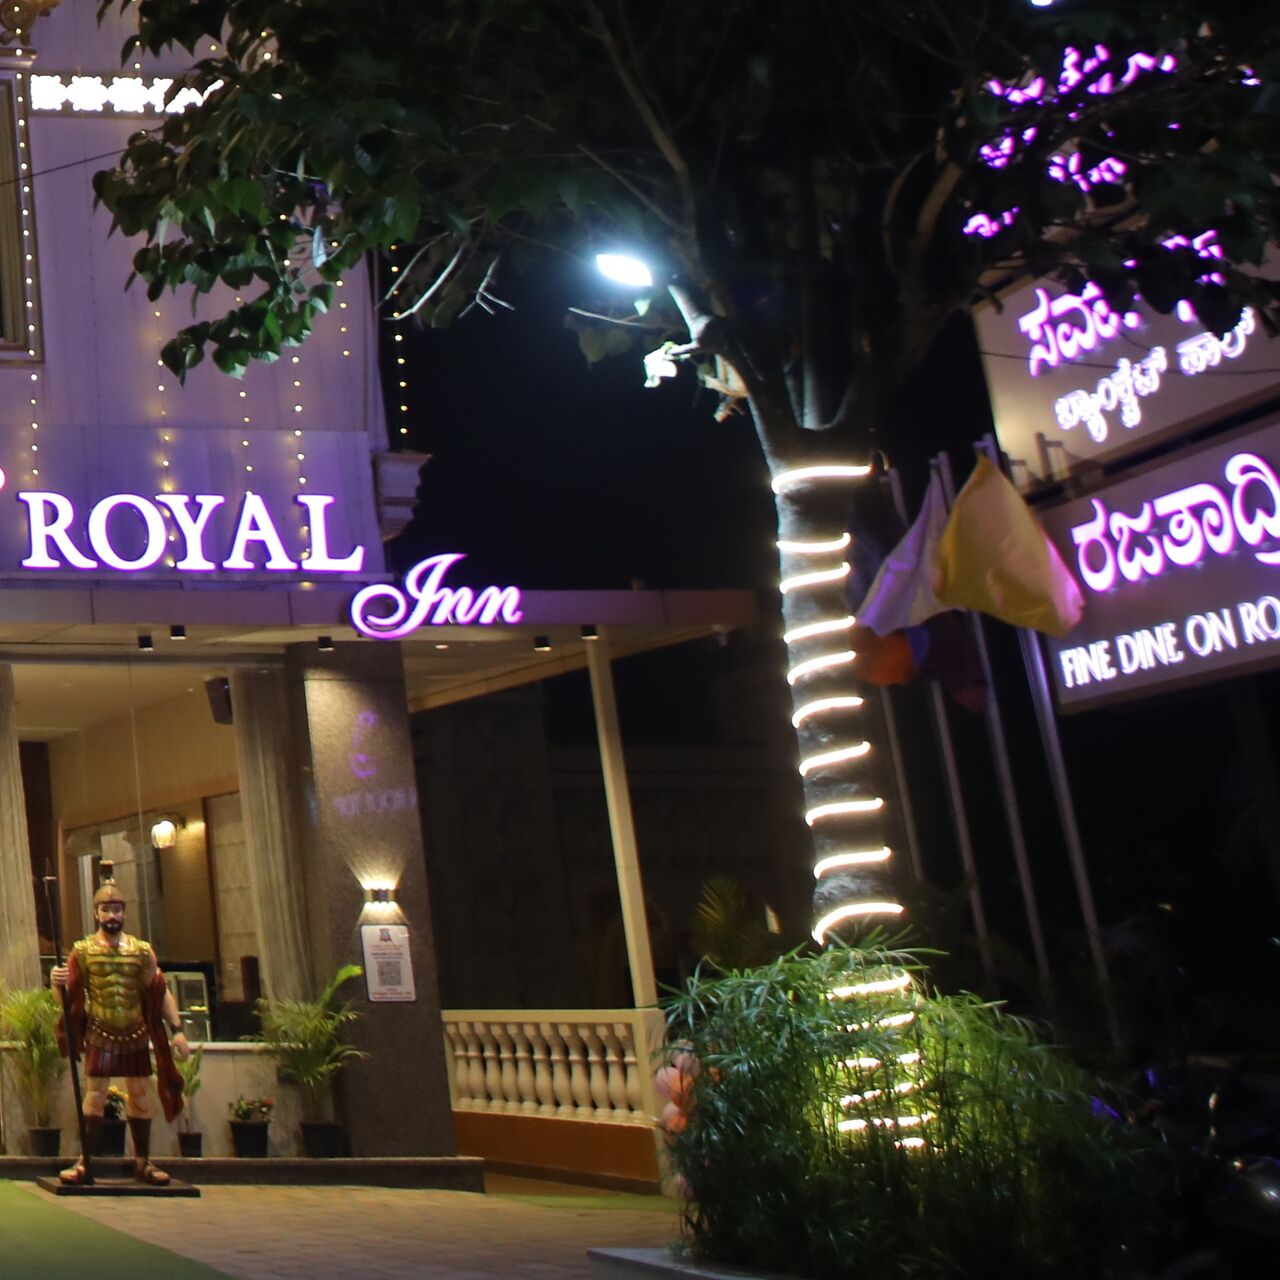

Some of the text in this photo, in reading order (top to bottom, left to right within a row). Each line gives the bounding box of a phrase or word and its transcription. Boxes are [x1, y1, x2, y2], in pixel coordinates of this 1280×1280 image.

[18, 490, 366, 572] ROYAL
[351, 553, 524, 638] Inn
[1059, 639, 1119, 688] FINE
[1115, 621, 1185, 674] DINE
[1184, 607, 1239, 657] ON
